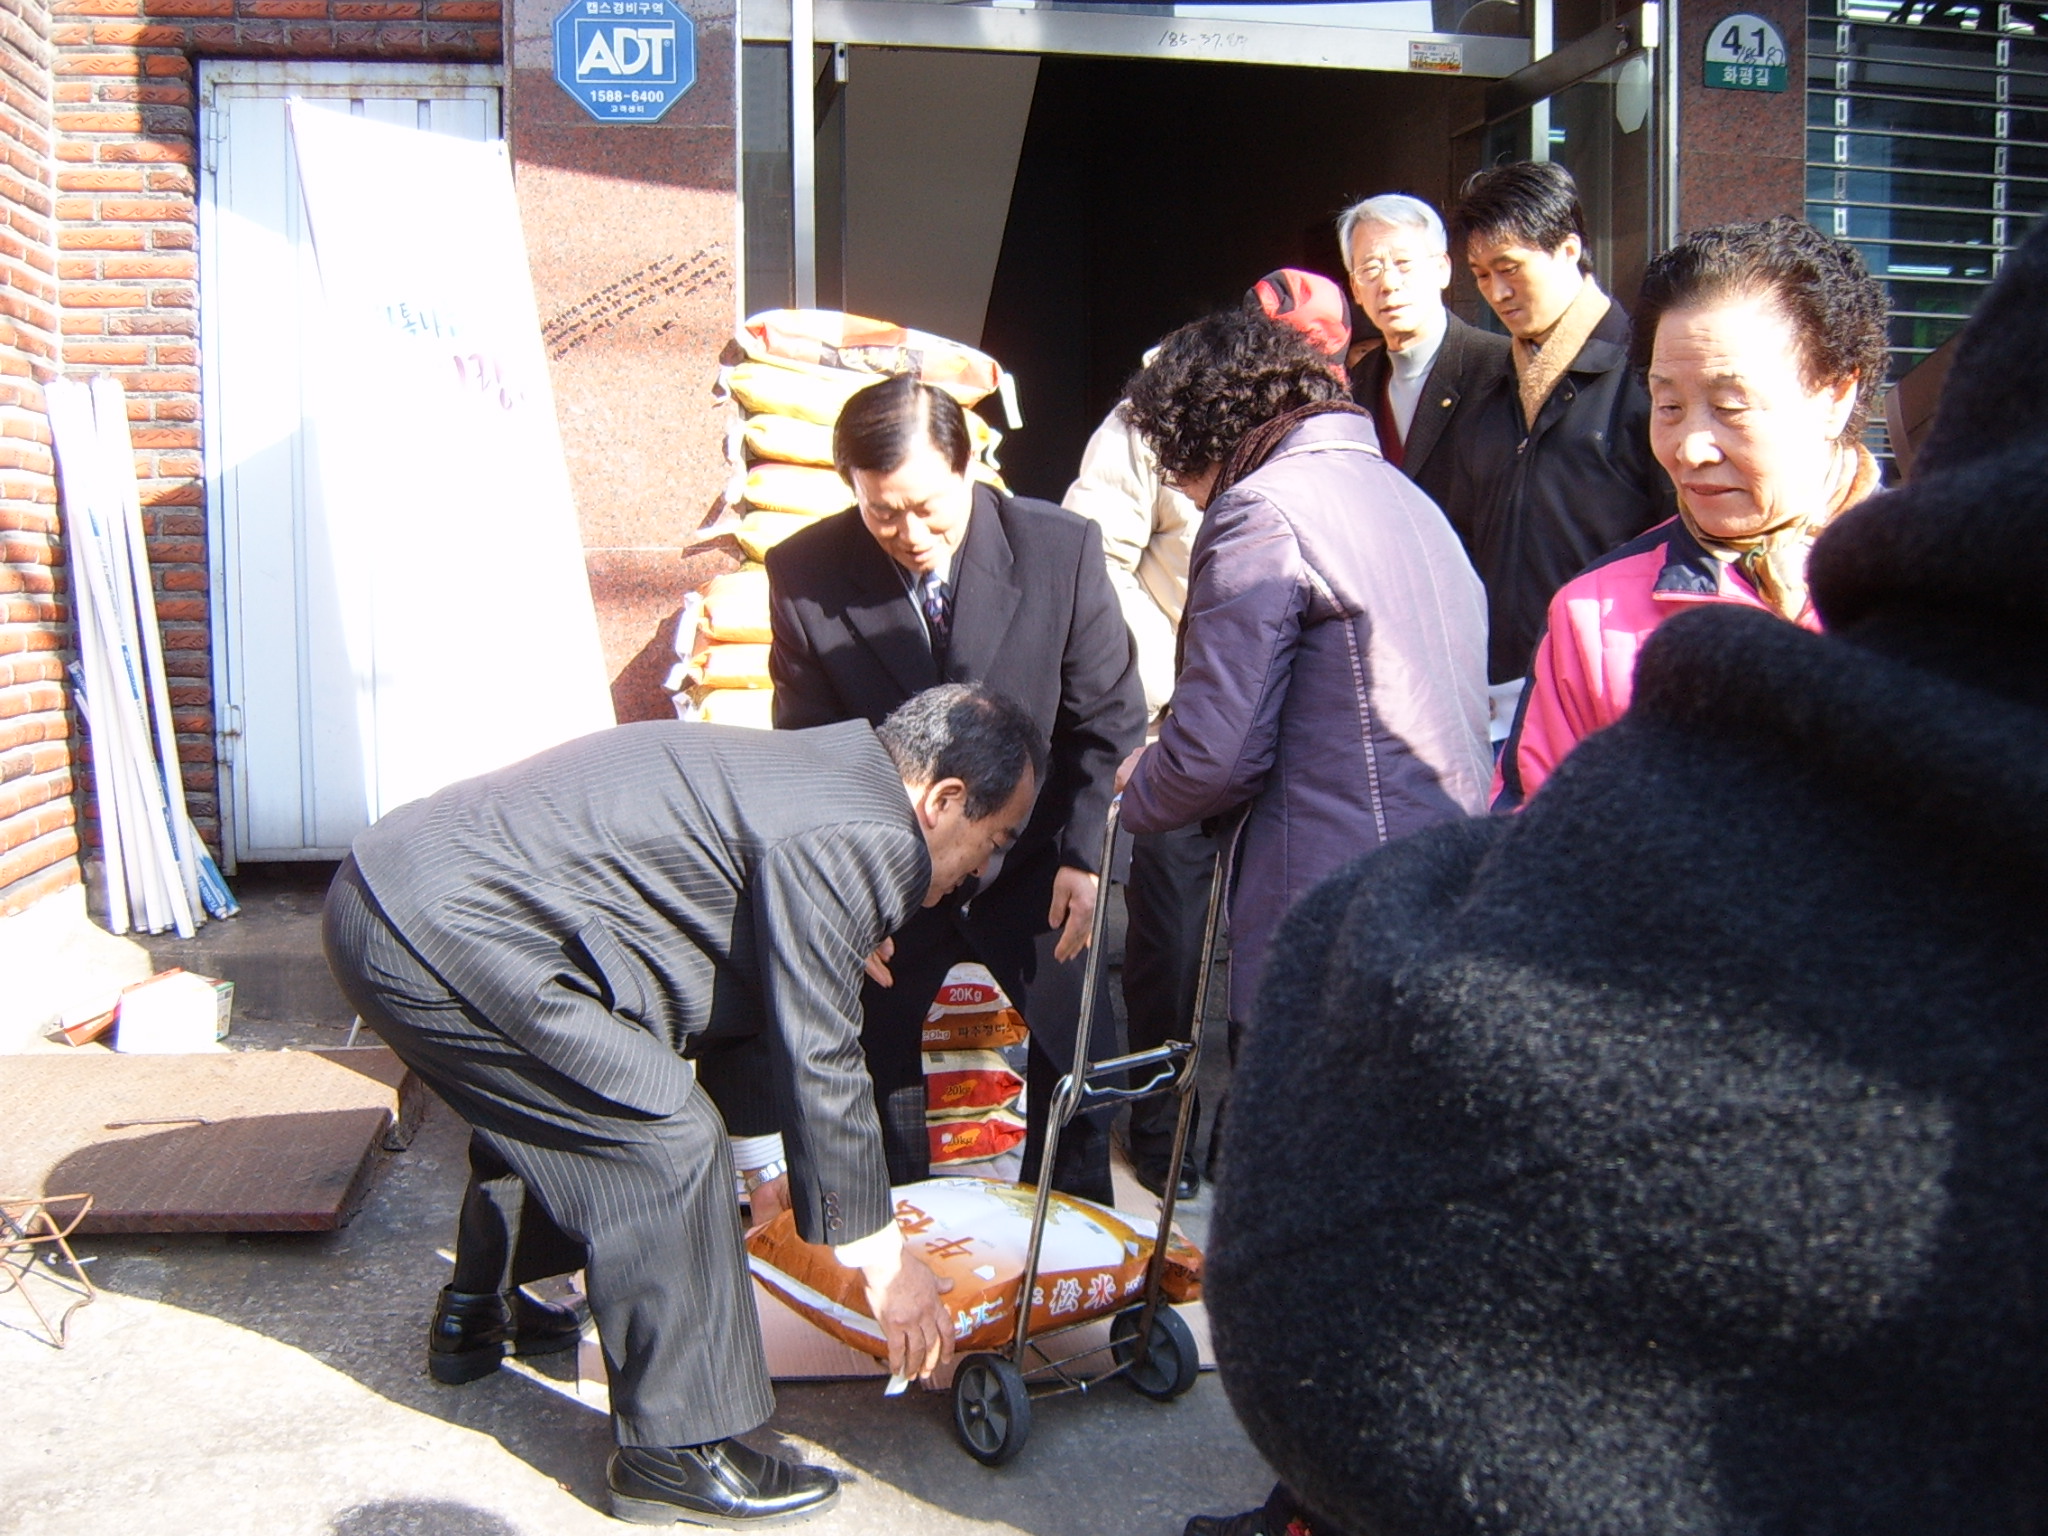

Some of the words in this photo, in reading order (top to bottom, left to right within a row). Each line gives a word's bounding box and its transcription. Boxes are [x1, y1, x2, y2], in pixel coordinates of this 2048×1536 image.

[577, 27, 674, 75] ADT
[1721, 25, 1765, 57] 41
[590, 89, 665, 103] 1588-6400
[949, 987, 983, 1002] 20Kg
